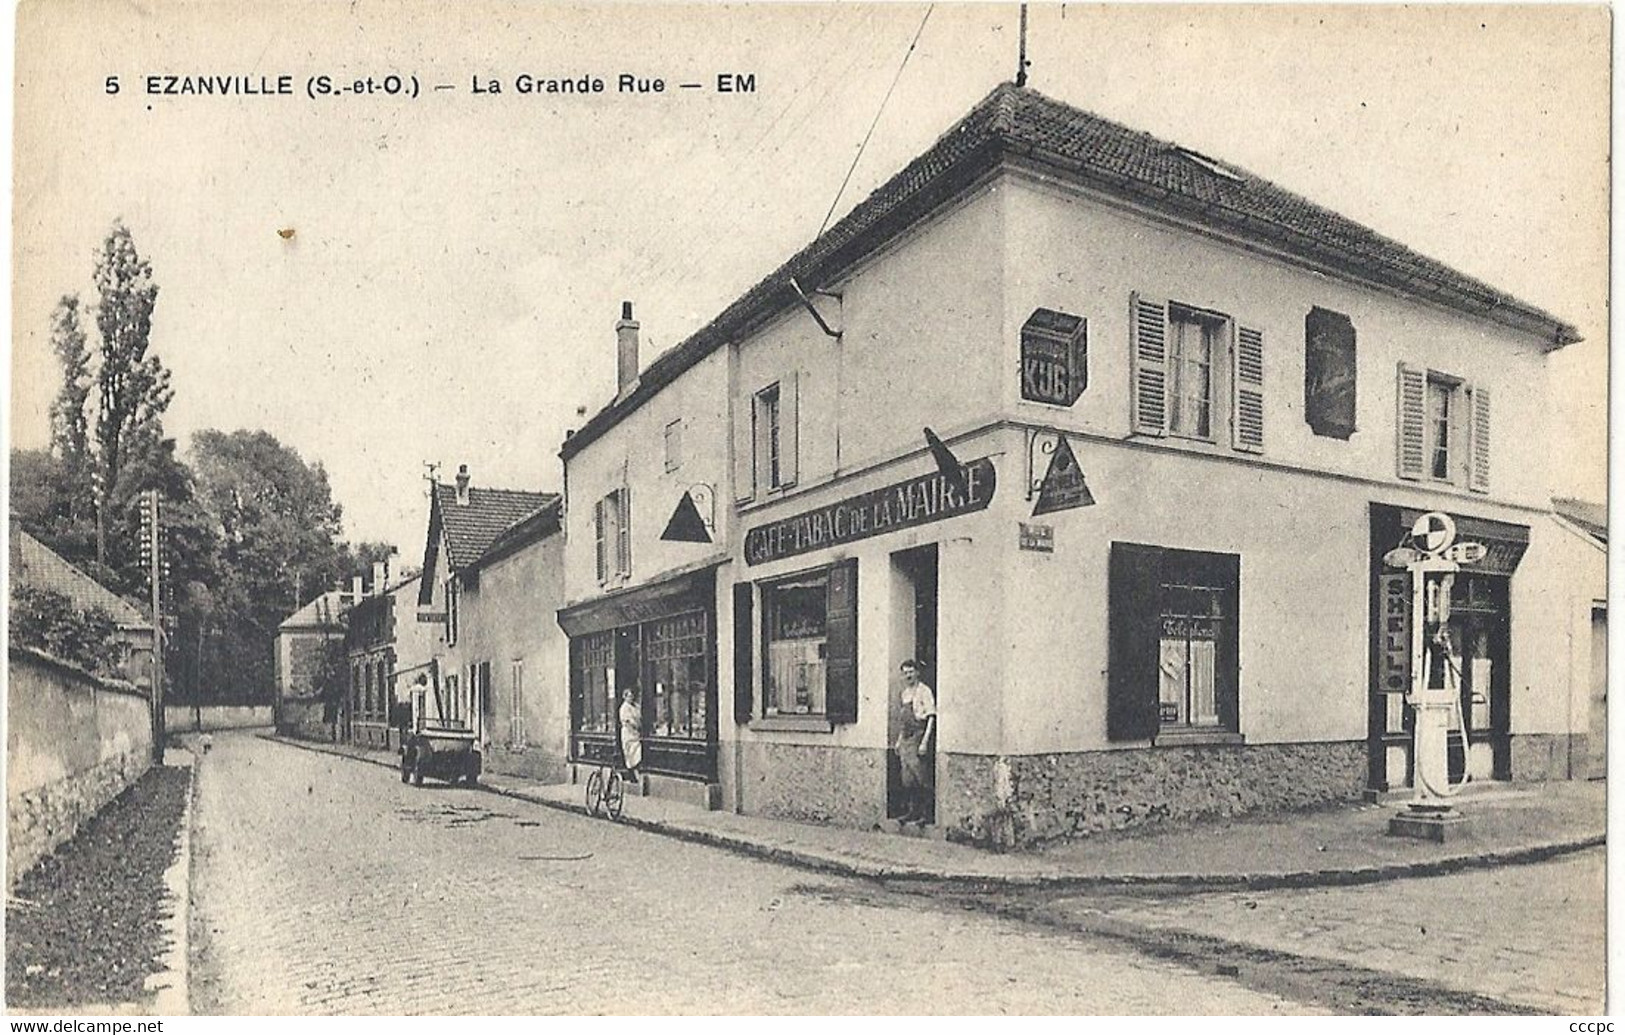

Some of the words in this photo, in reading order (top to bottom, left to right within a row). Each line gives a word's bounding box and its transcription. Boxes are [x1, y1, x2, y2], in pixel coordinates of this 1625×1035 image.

[1023, 357, 1067, 401] KUB
[792, 505, 846, 550] TABAC
[850, 506, 869, 535] DE
[873, 499, 892, 529] LA
